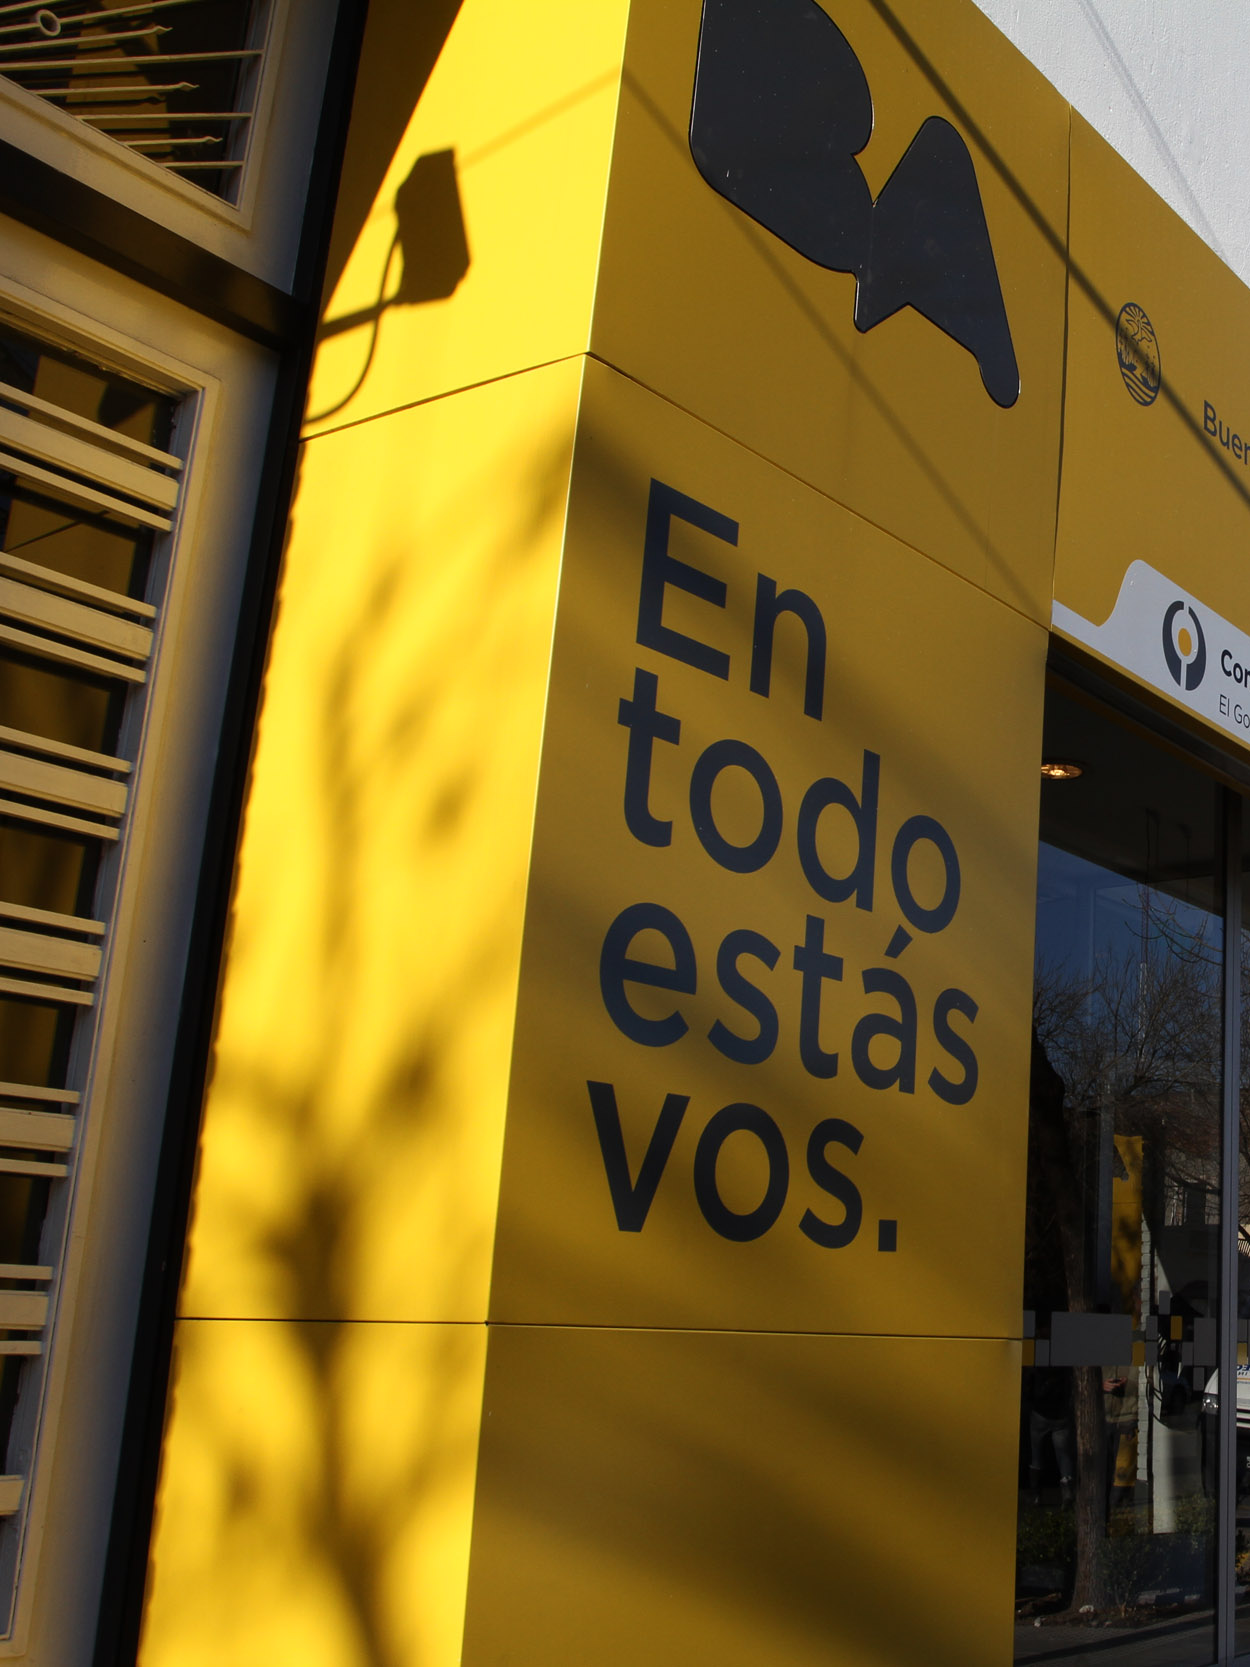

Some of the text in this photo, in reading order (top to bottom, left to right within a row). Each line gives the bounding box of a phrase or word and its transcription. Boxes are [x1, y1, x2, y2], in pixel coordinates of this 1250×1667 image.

[635, 477, 827, 722] En
[616, 666, 962, 934] todo
[1218, 693, 1230, 717] El
[599, 901, 980, 1106] estás
[586, 1079, 898, 1252] vos.
